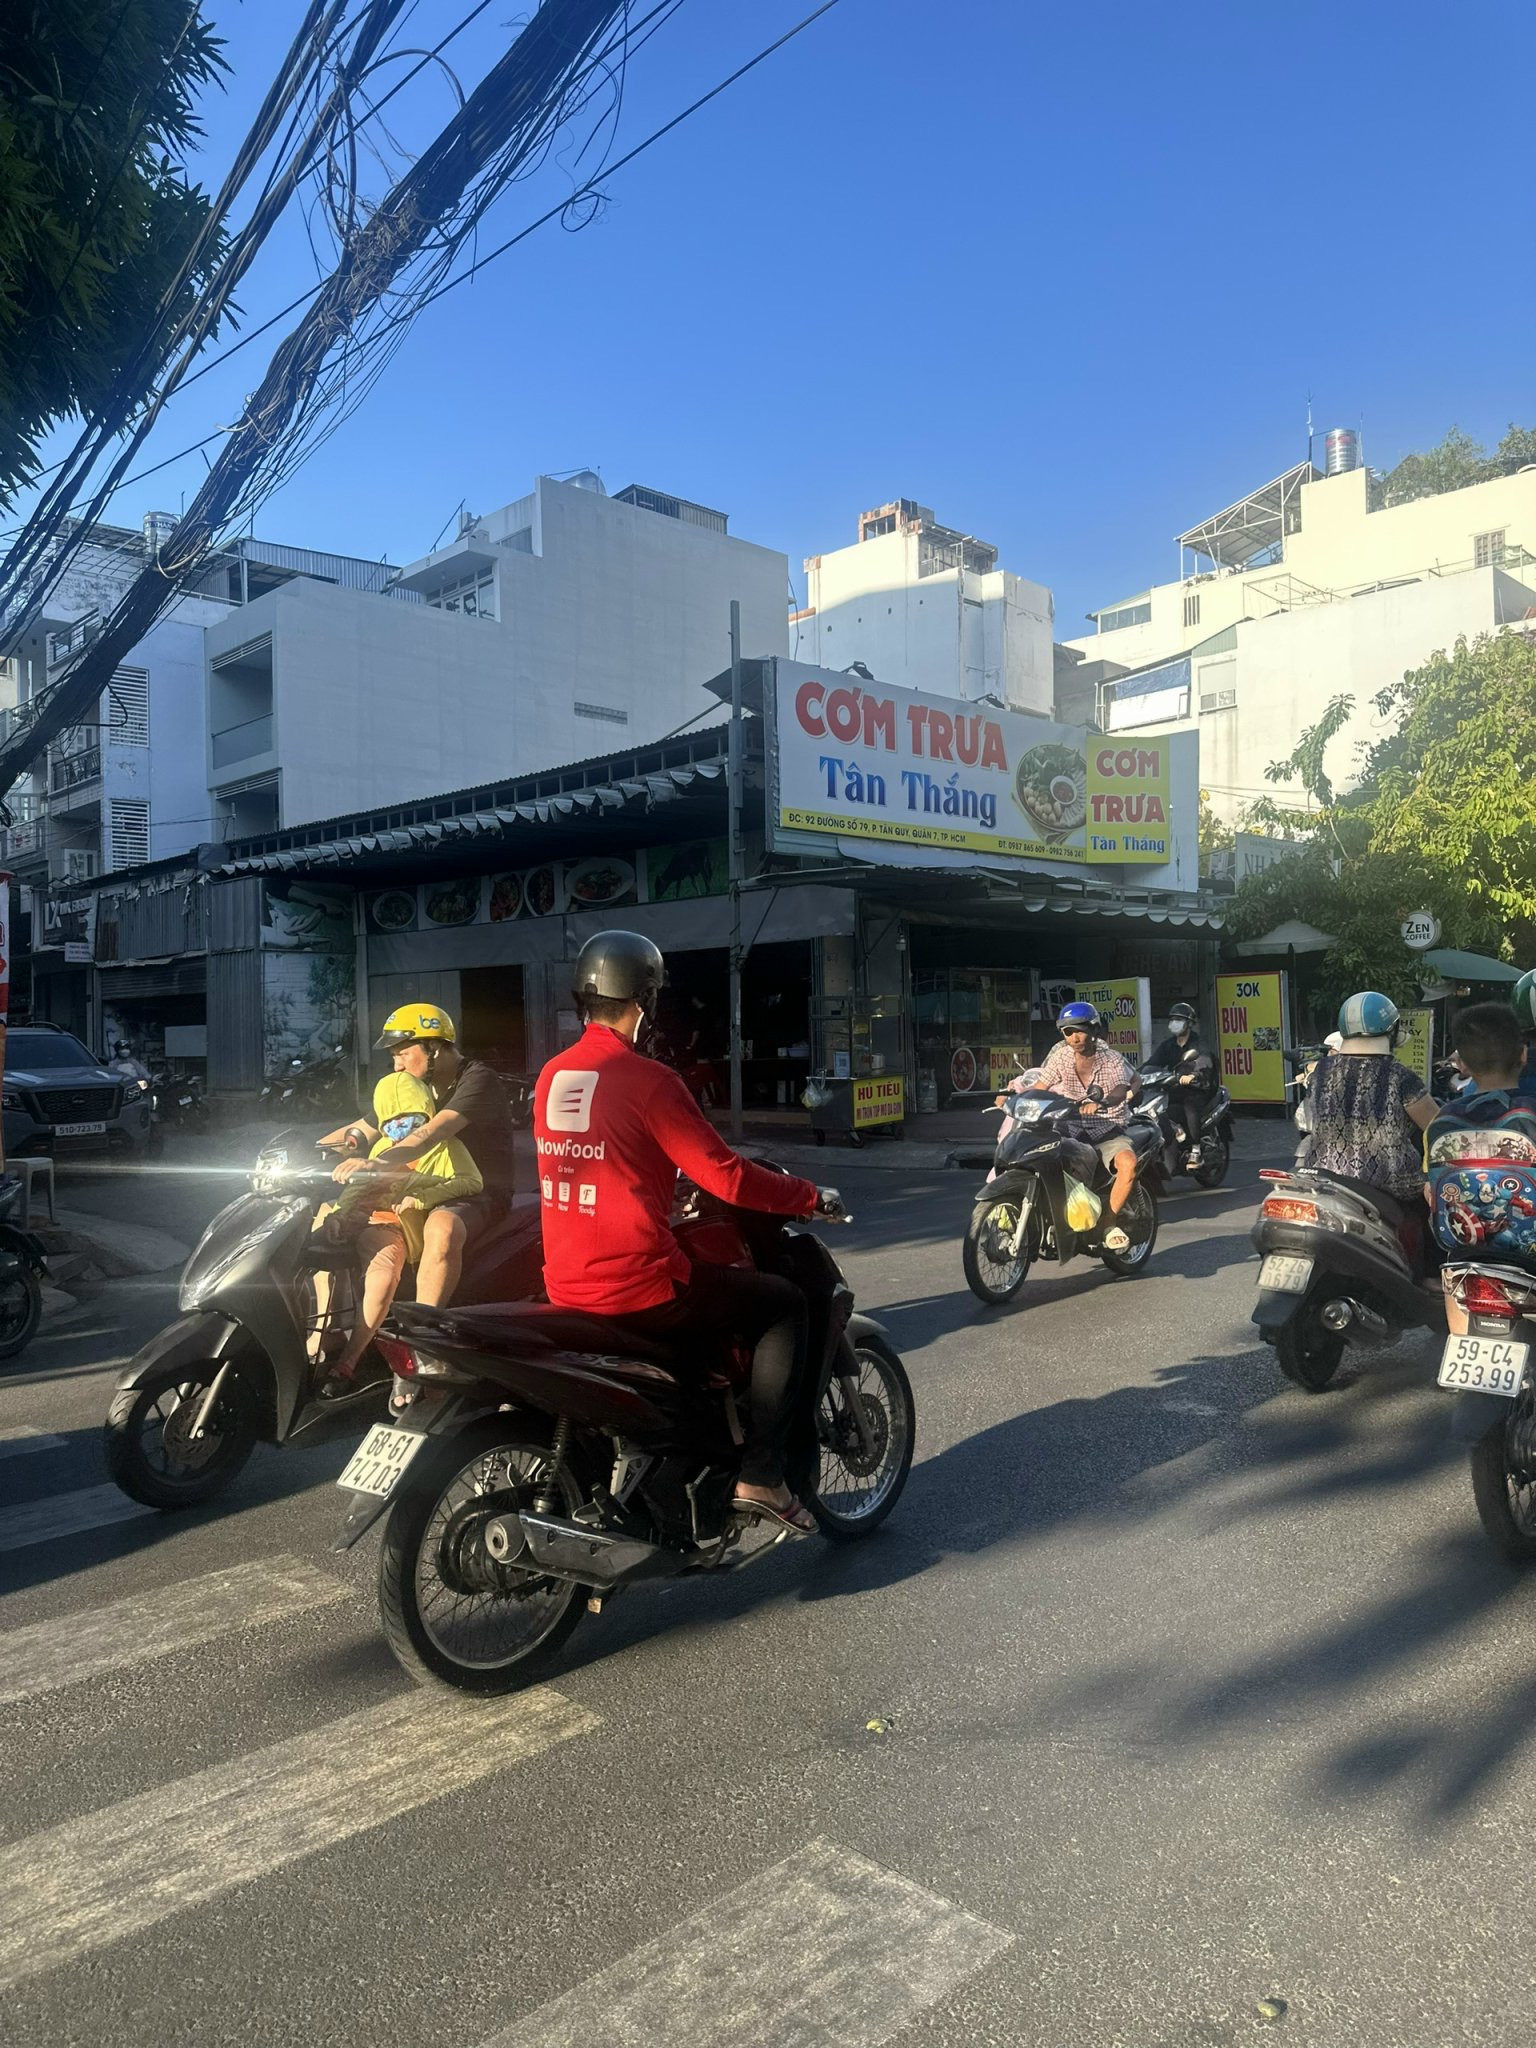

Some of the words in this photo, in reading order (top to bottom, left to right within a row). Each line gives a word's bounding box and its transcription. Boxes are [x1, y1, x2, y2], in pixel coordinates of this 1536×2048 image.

[795, 680, 897, 752] CƠM
[907, 704, 1008, 772] TRƯA
[1096, 748, 1160, 778] CƠM
[819, 755, 887, 807] Tân
[901, 771, 997, 829] Thắng
[1090, 793, 1166, 823] TRƯA
[805, 813, 815, 825] 92
[950, 834, 966, 844] HCM
[1405, 933, 1431, 941] COFFEE
[1236, 982, 1260, 998] 30K
[1115, 996, 1136, 1018] 30K
[1221, 1001, 1248, 1034] BÚN
[419, 1015, 441, 1030] be
[1223, 1042, 1253, 1075] RIÊU
[858, 1082, 873, 1101] HỦ
[876, 1079, 900, 1098] TIẾU
[537, 1137, 605, 1160] NowFood
[1480, 1321, 1506, 1329] HONDA
[1456, 1339, 1513, 1366] 59-C4
[1445, 1362, 1515, 1391] 253.99
